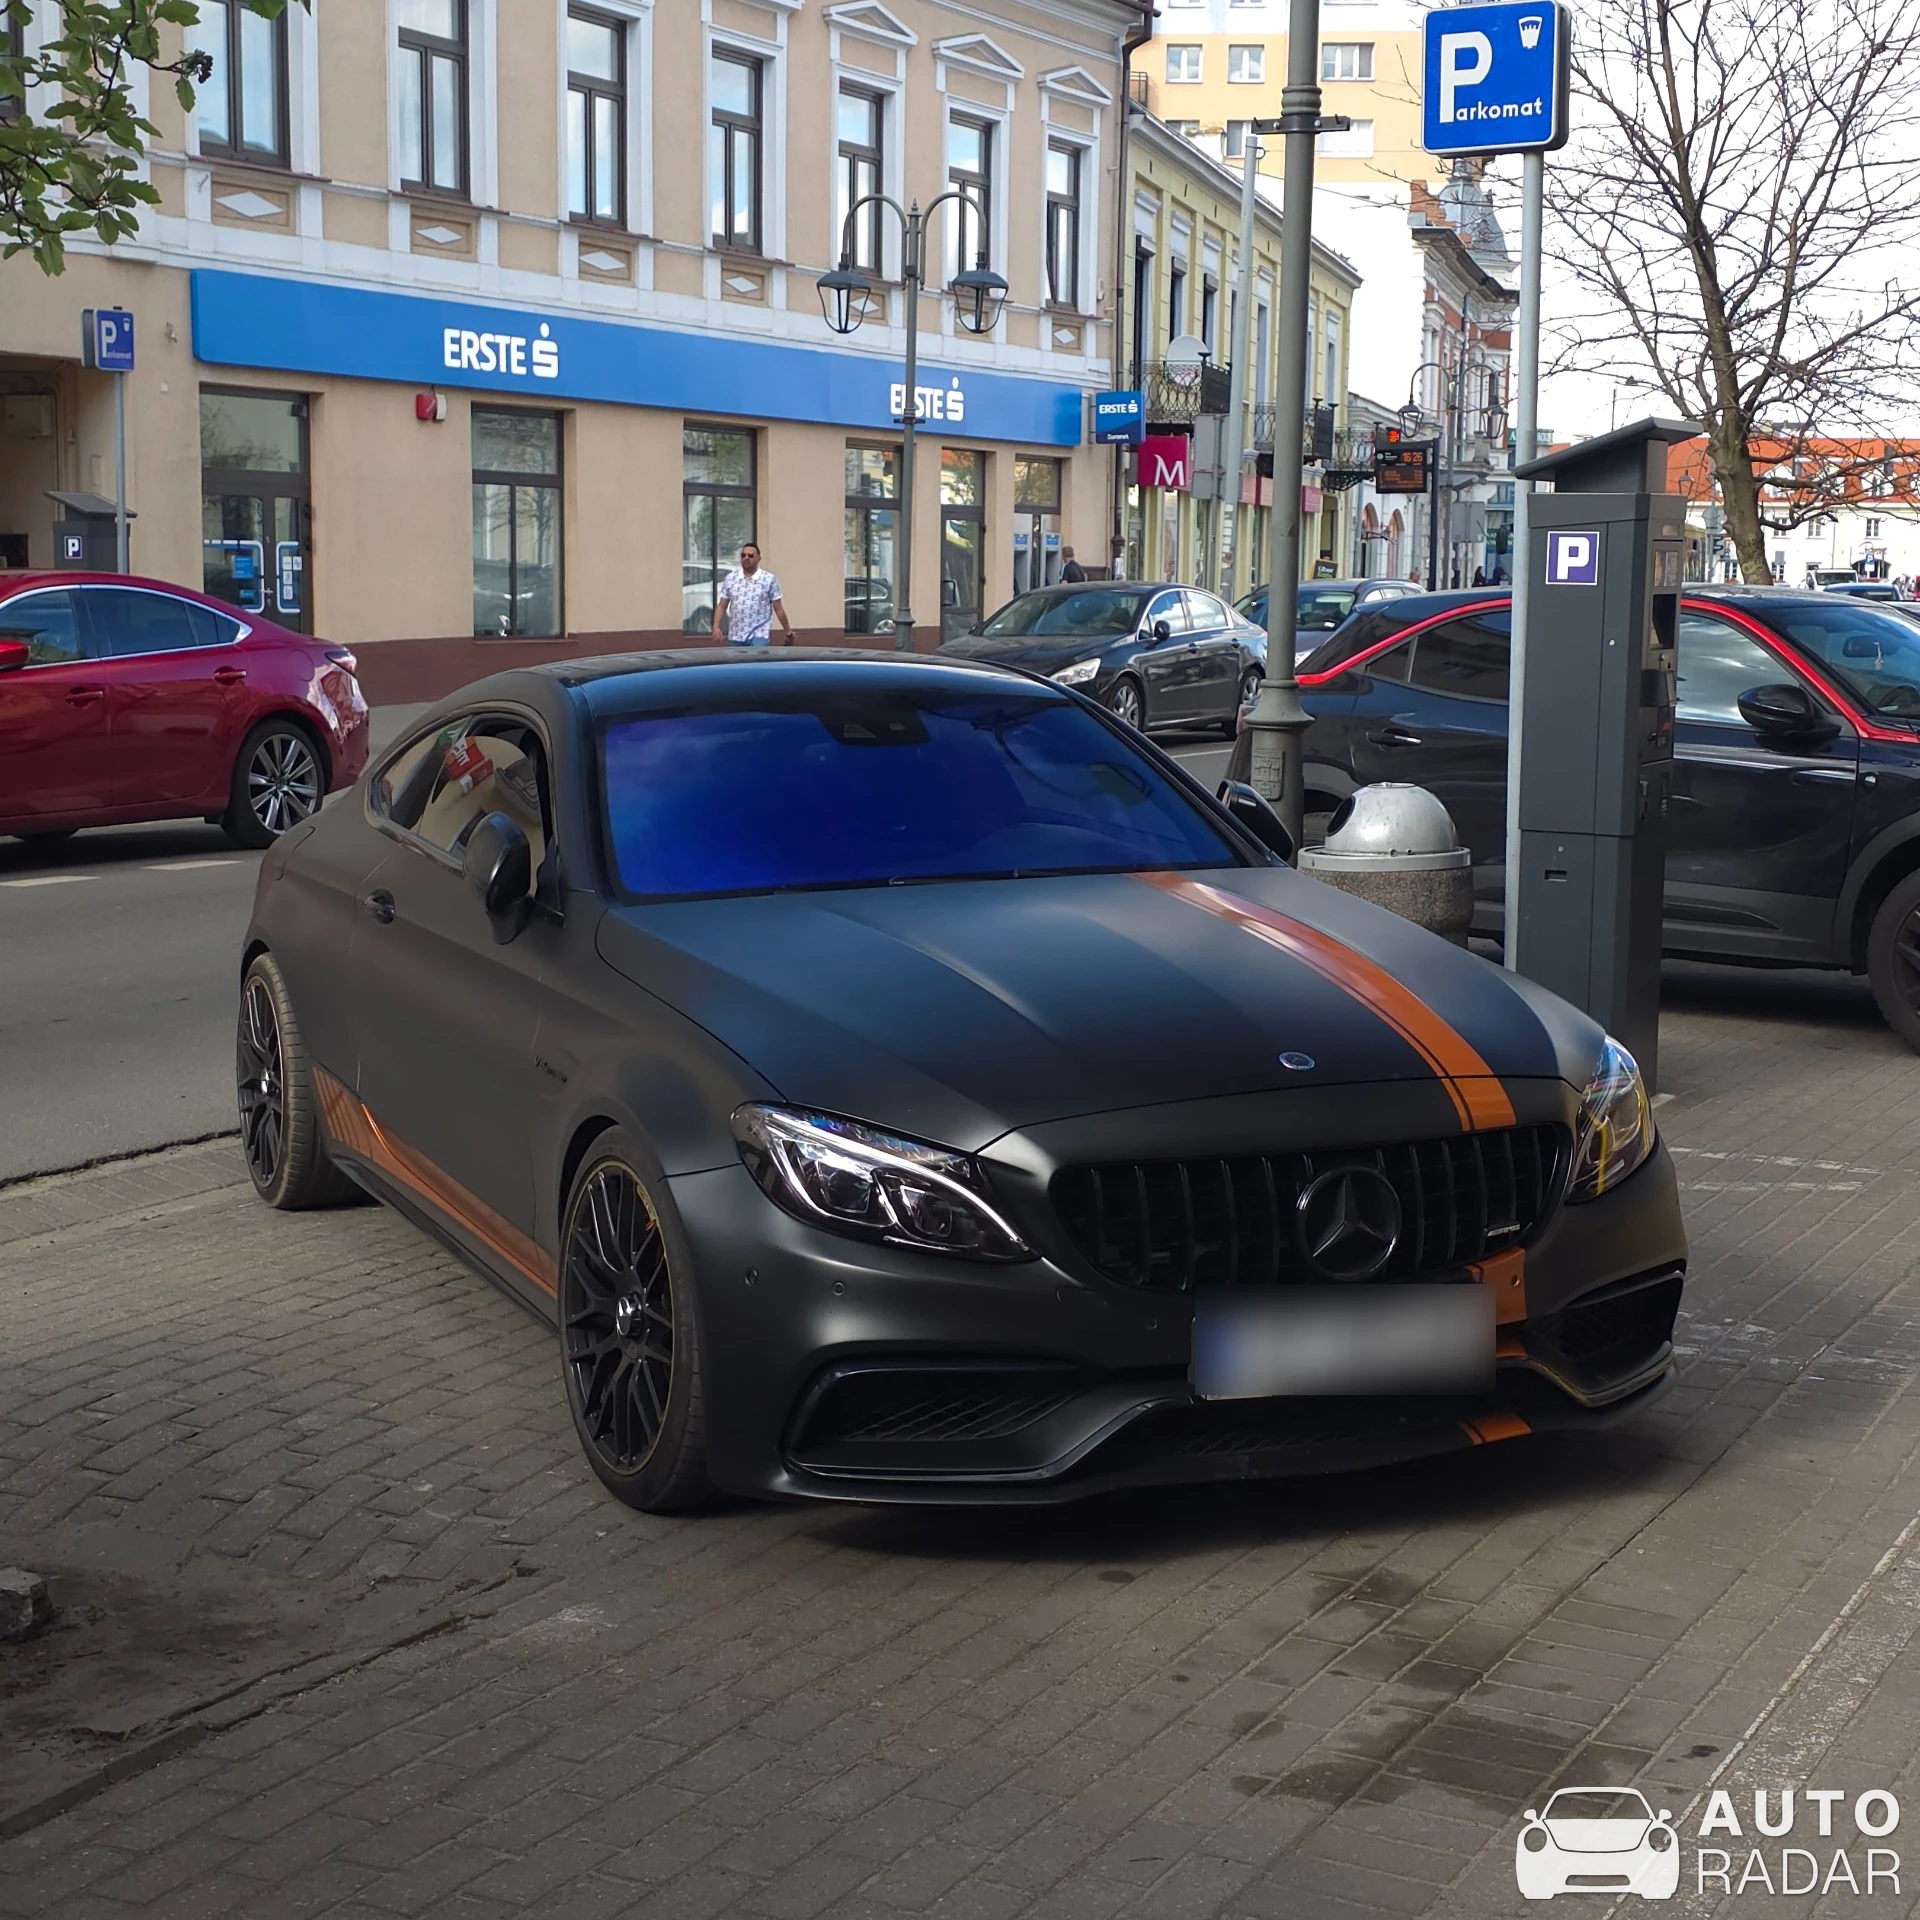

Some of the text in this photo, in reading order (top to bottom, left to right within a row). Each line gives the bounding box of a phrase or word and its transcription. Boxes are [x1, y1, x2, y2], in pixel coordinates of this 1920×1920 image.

[443, 327, 527, 376] ERSTE
[1099, 404, 1127, 414] ERSTE
[1153, 454, 1185, 486] M
[68, 538, 80, 557] P
[1556, 535, 1591, 580] P
